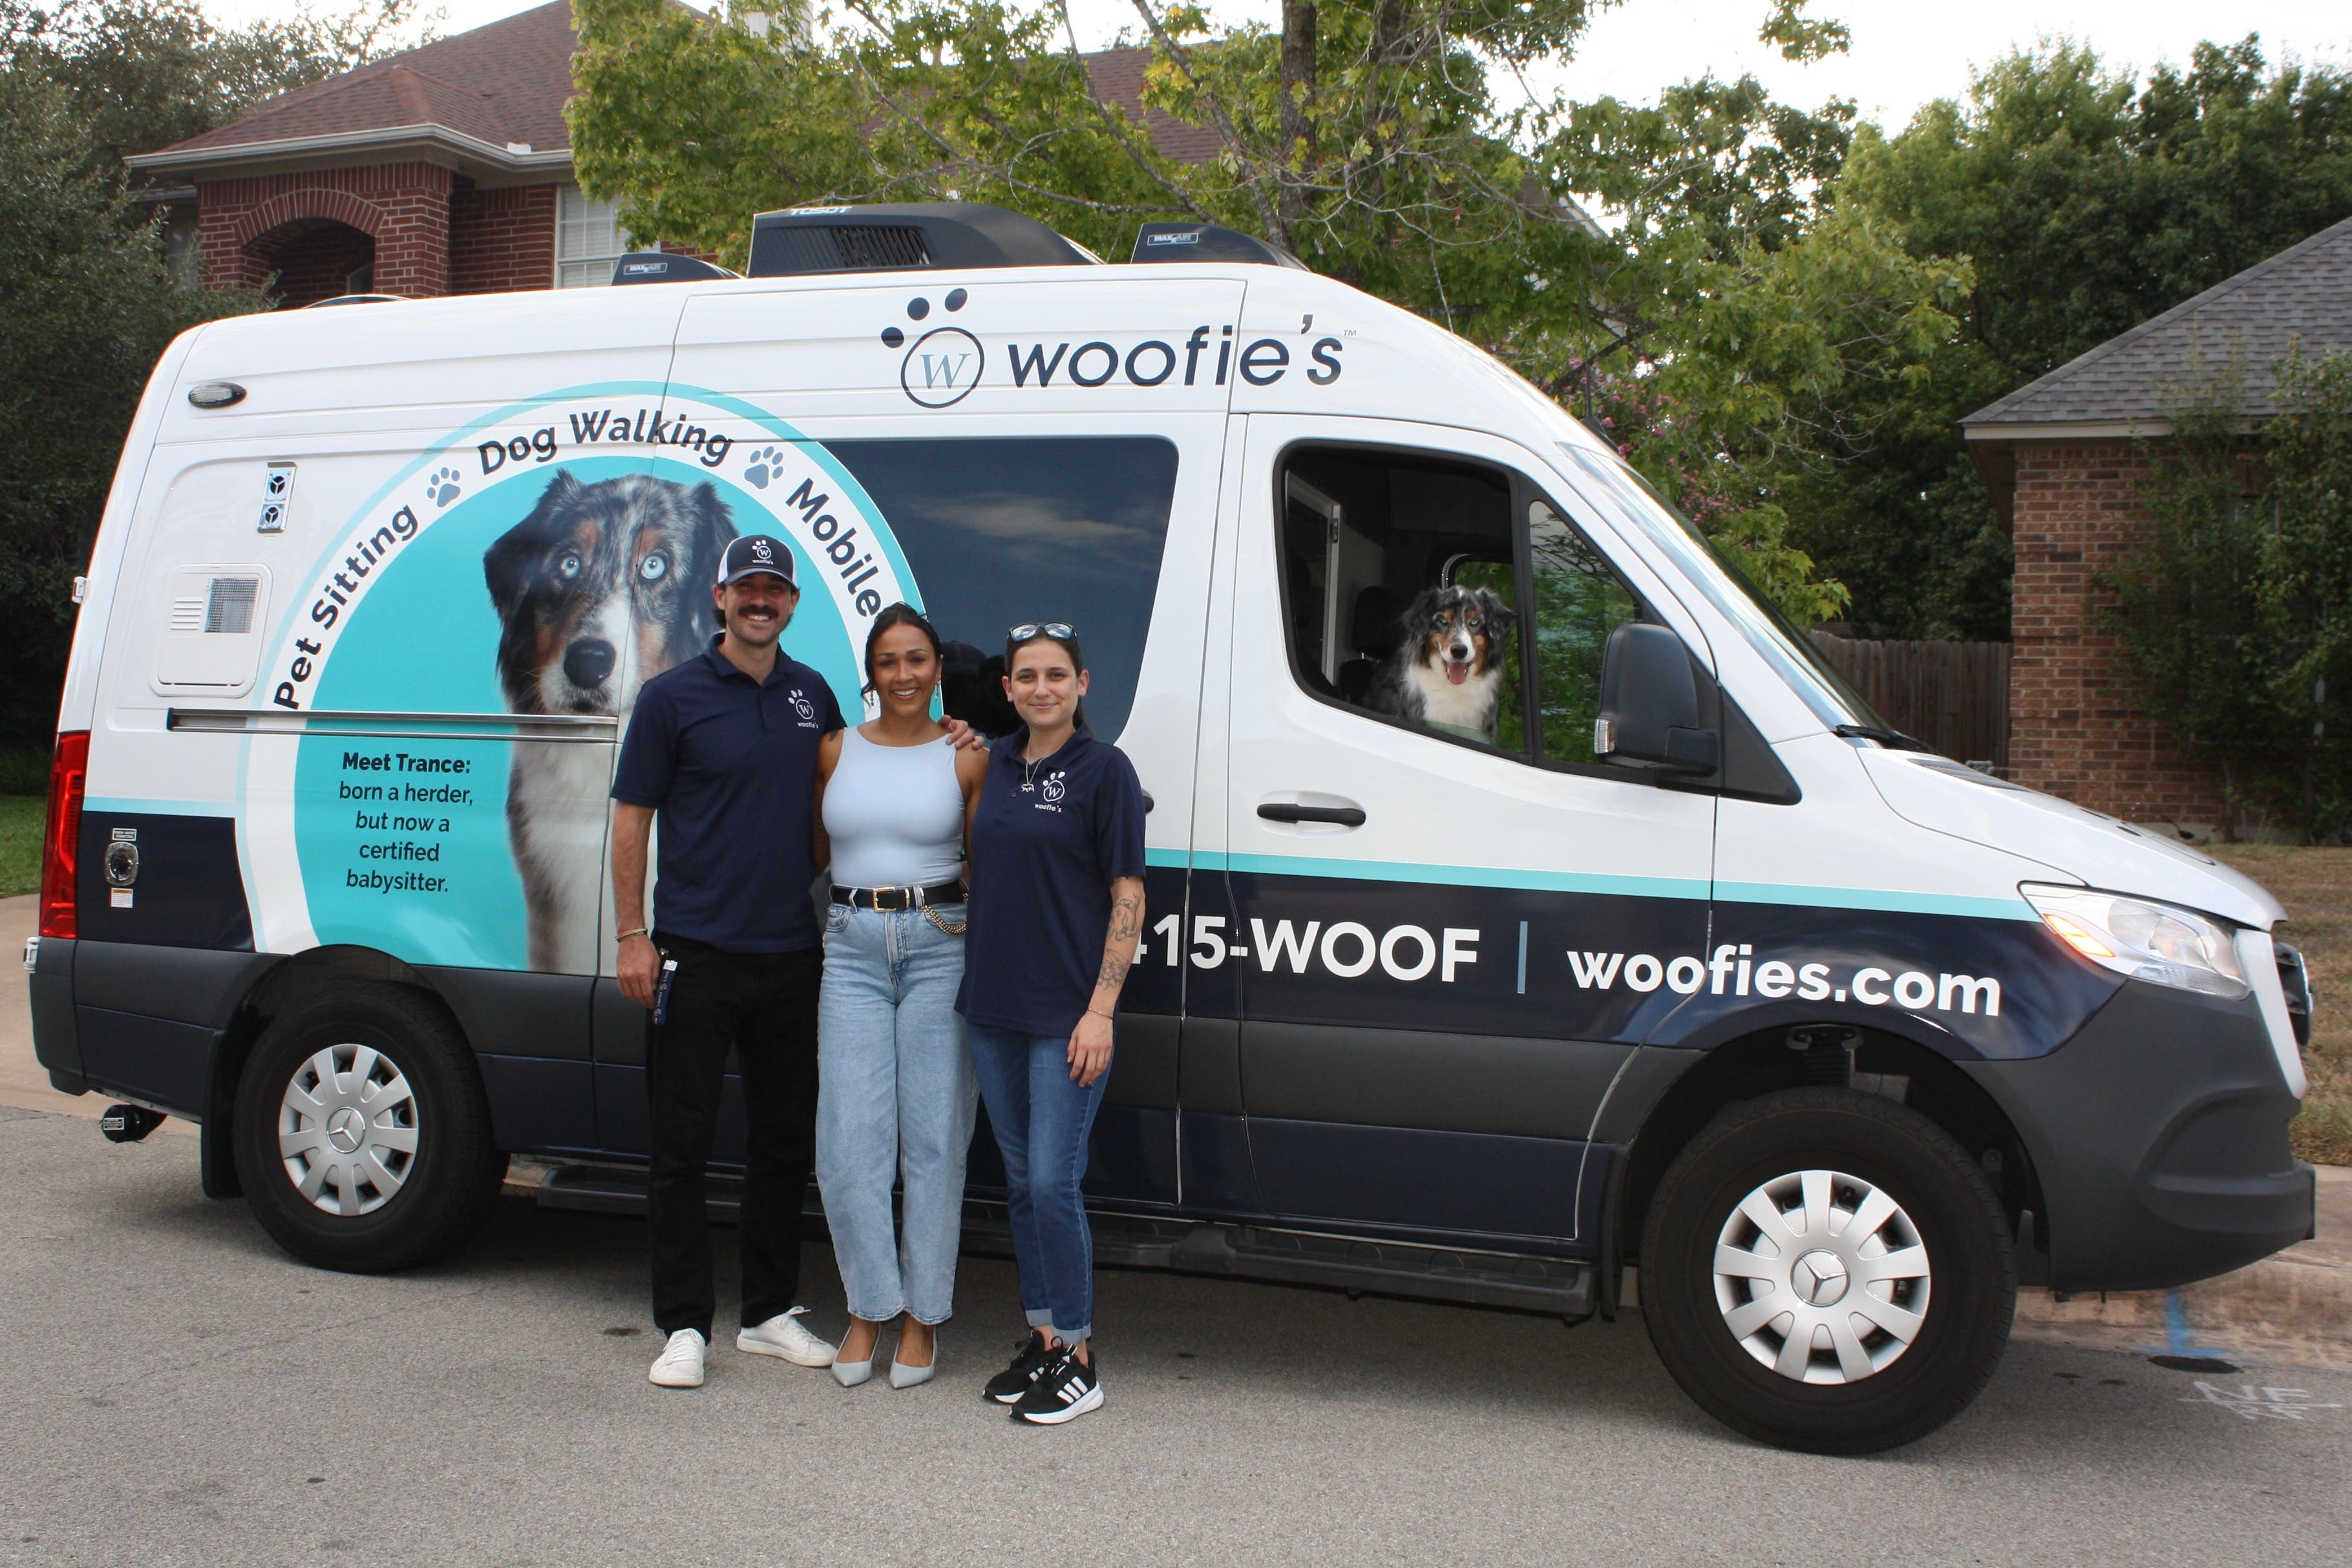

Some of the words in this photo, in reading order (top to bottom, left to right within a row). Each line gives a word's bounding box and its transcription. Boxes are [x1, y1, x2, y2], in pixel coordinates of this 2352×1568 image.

[790, 206, 852, 216] TOSOT
[1008, 313, 1343, 387] woofie's
[478, 425, 558, 476] Dog
[569, 409, 735, 467] Walking
[785, 477, 882, 618] Mobile
[273, 637, 322, 710] Pet
[312, 504, 419, 630] Sitting
[343, 752, 391, 770] Meet
[396, 754, 471, 774] Trance:
[339, 781, 383, 800] born
[388, 787, 399, 801] a
[405, 783, 473, 806] herder,
[355, 810, 388, 830] but
[392, 816, 435, 831] now
[438, 818, 450, 832] a
[359, 842, 440, 862] certified
[346, 869, 448, 895] babysitter.
[1567, 944, 2000, 1017] woofies.com
